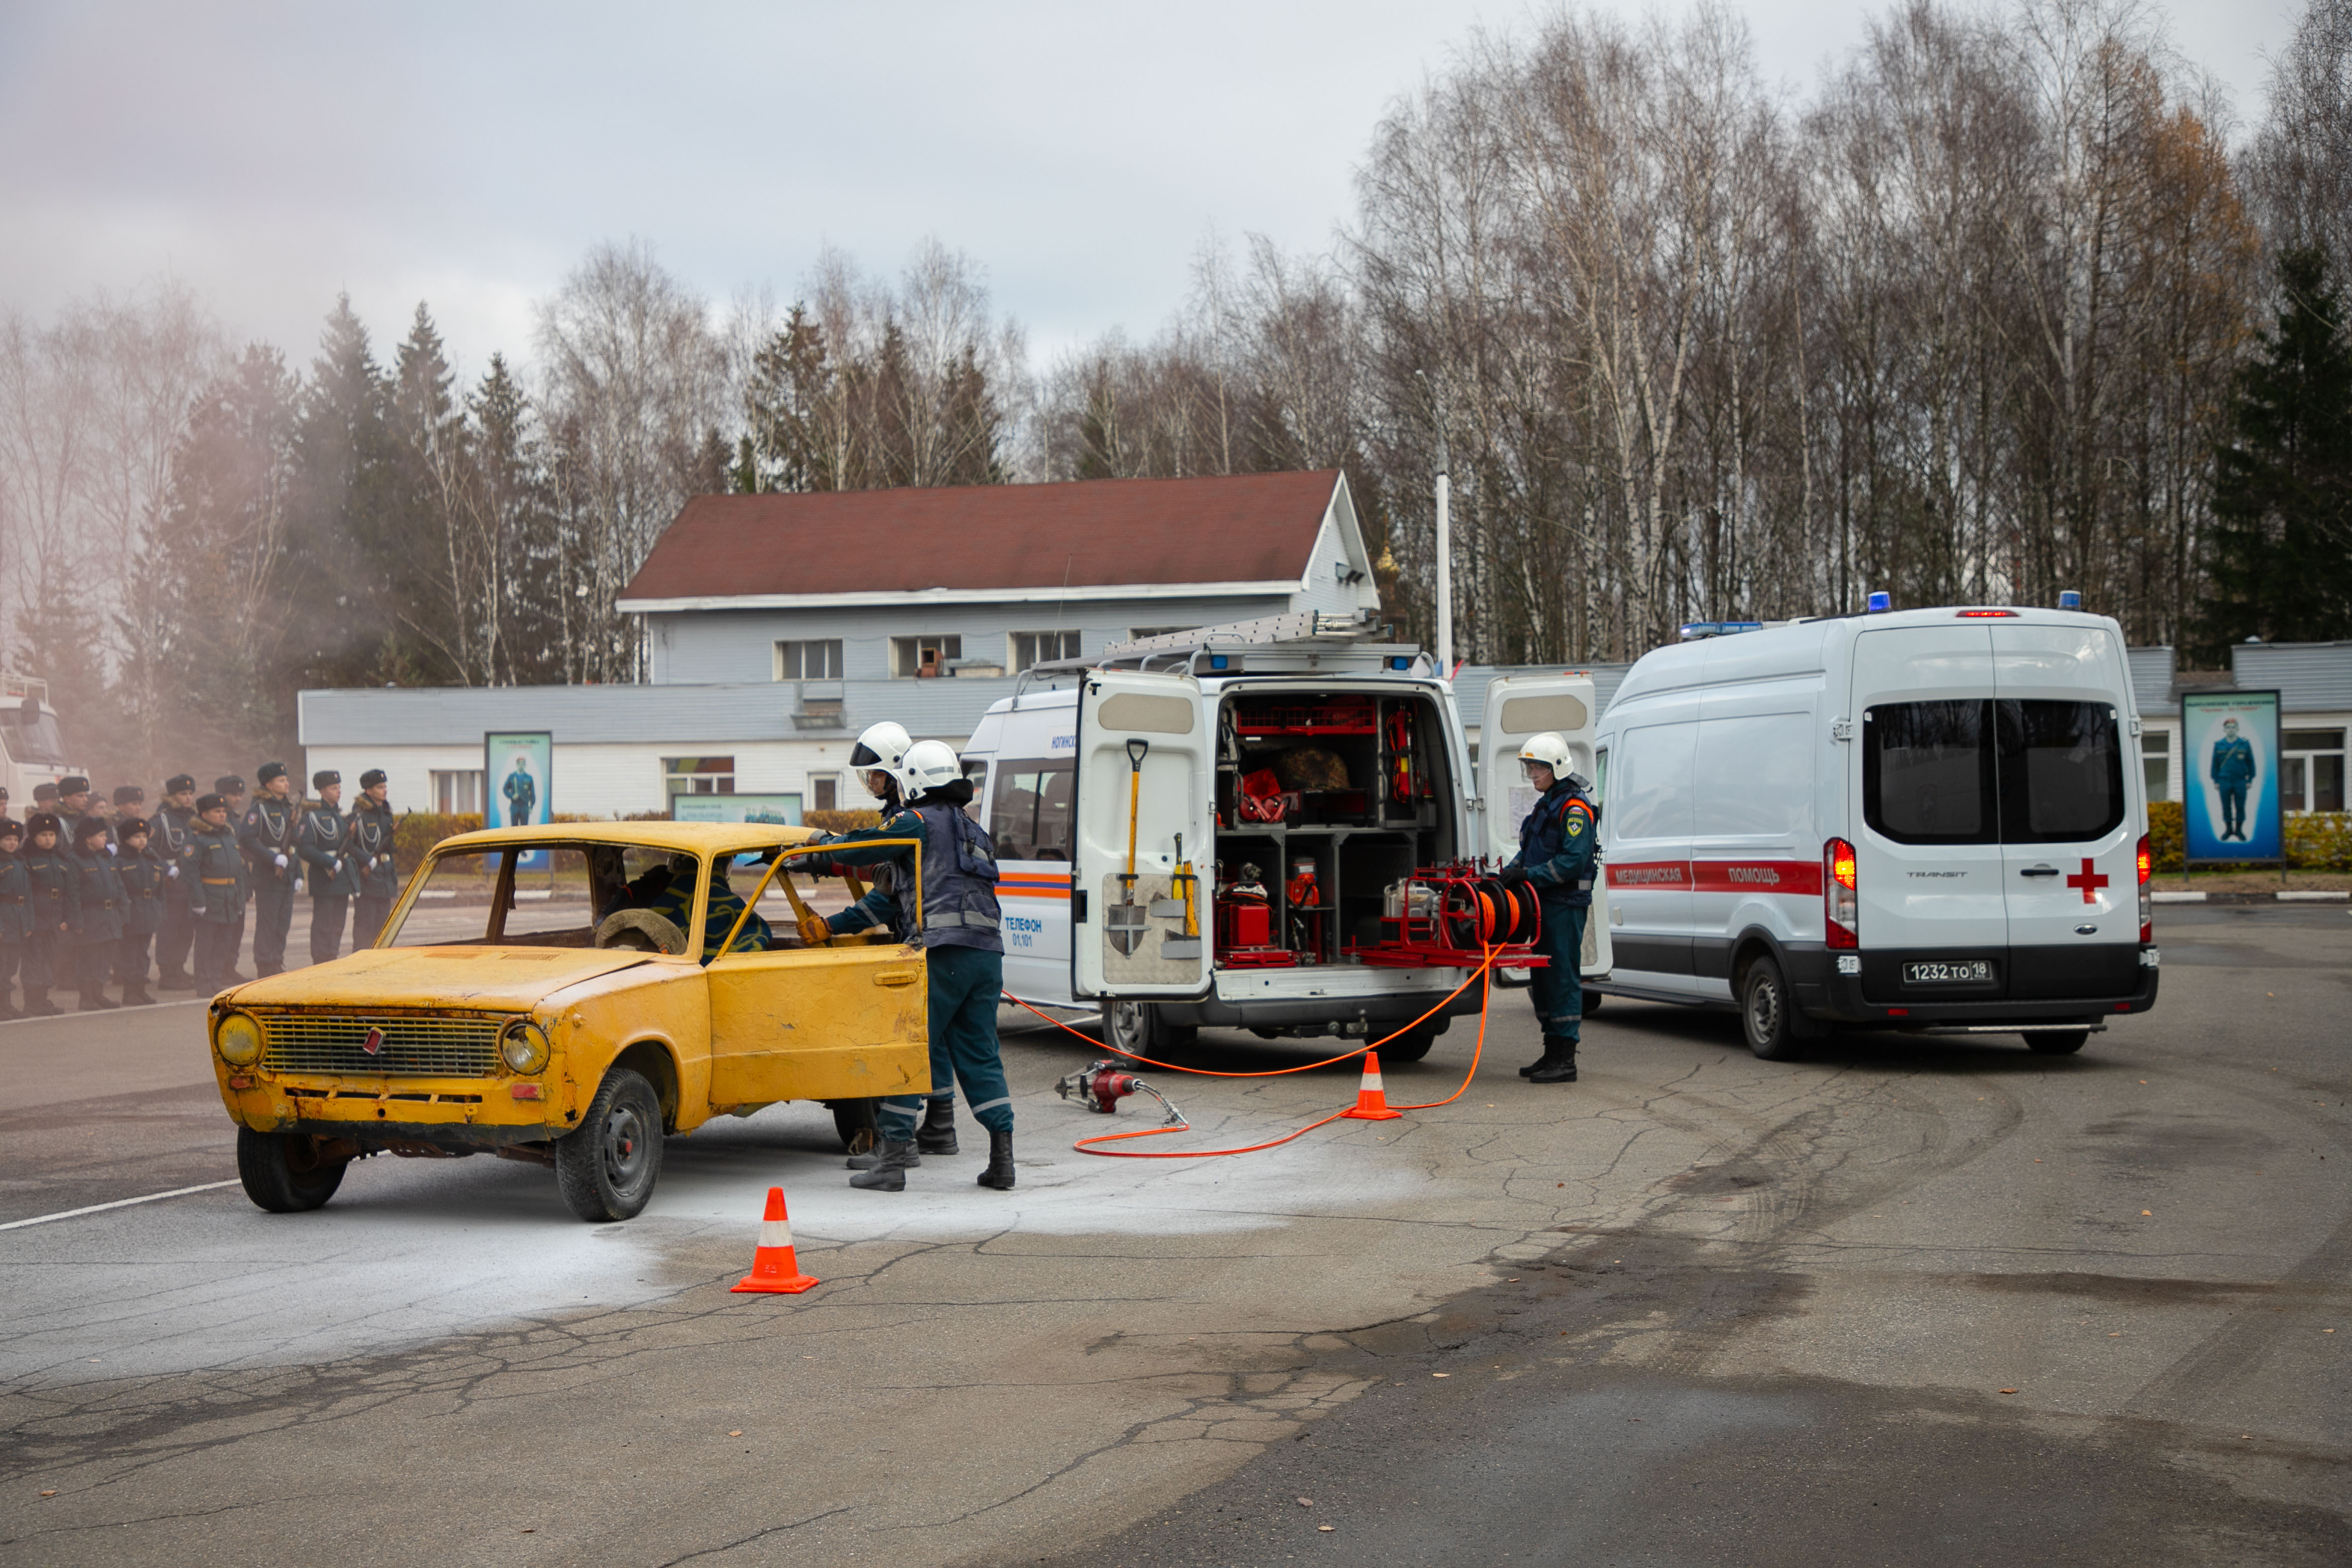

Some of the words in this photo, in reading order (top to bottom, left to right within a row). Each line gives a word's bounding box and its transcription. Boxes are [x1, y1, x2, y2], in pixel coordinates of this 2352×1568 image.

[1615, 867, 1683, 885] МЕДИЦИНСКАЯ
[1728, 867, 1780, 886] ПОМОЩЬ
[1005, 917, 1042, 933] ТЕЛЕФОН
[1012, 933, 1032, 948] 01,101
[1911, 964, 1948, 979] 1232
[1972, 962, 1986, 973] 18
